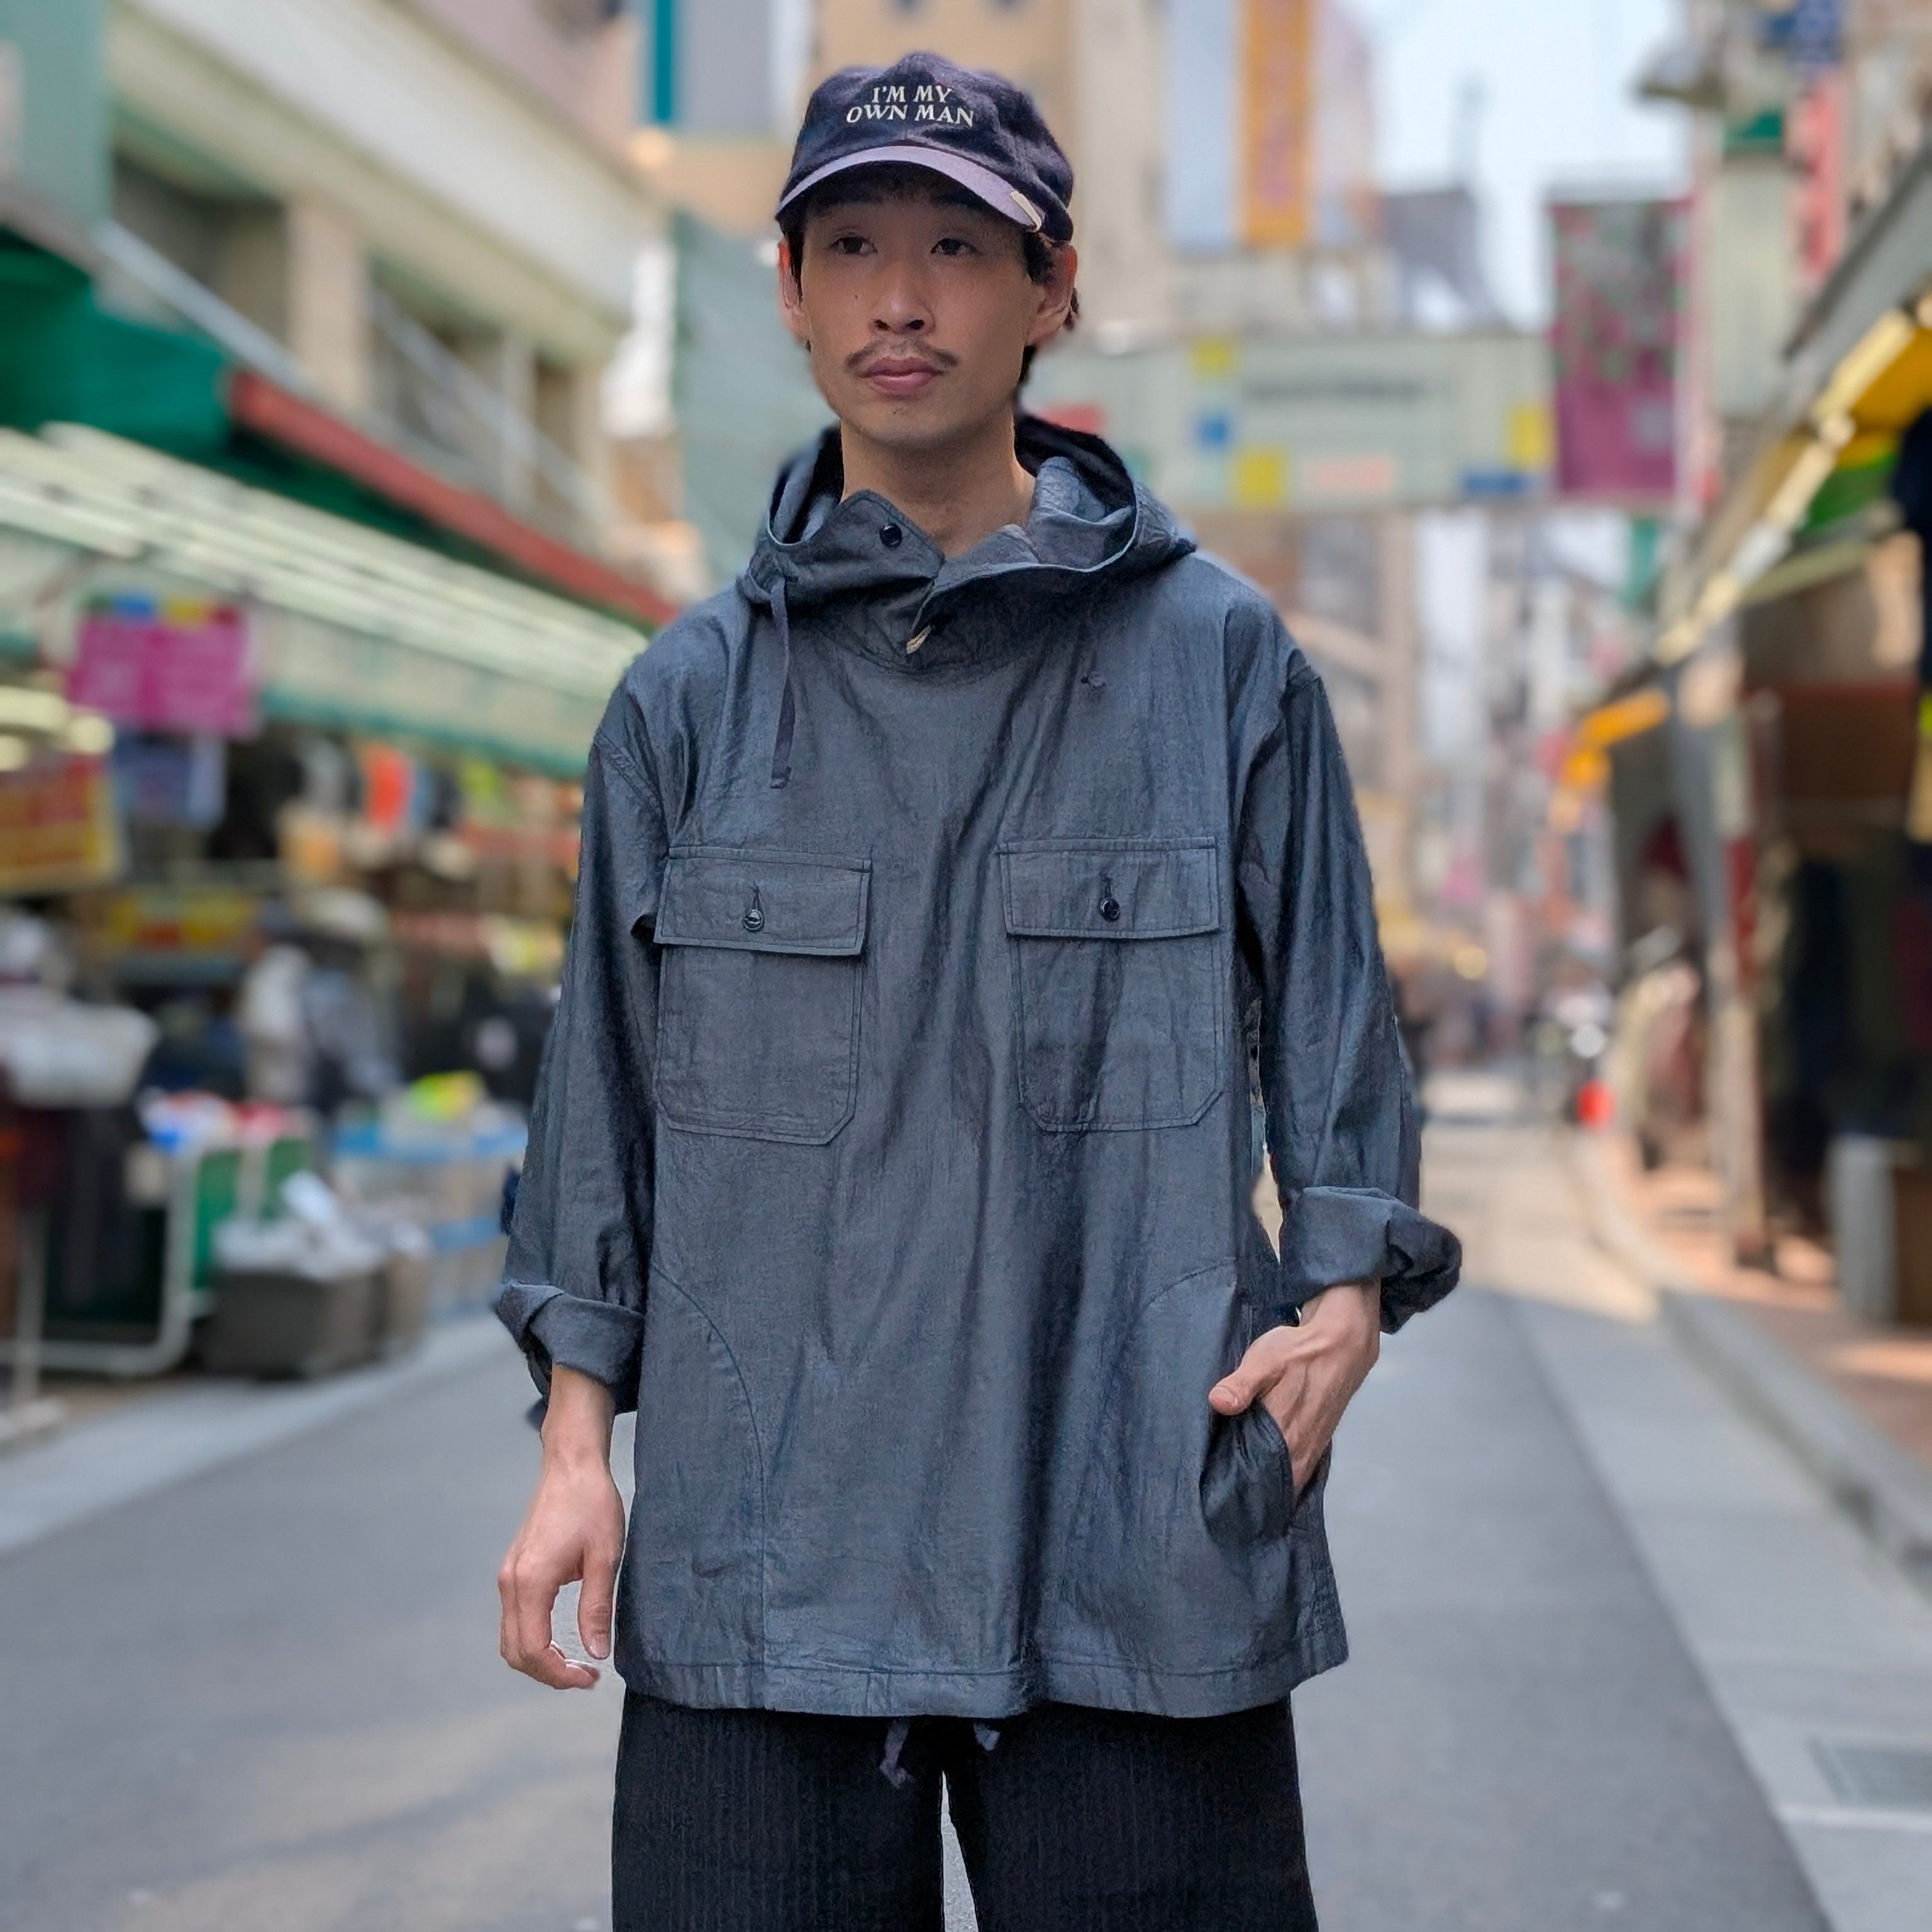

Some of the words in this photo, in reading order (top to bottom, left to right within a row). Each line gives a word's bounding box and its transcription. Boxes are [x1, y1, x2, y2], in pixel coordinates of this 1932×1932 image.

[872, 86, 906, 103] I'M
[913, 85, 953, 103] MY
[846, 104, 908, 123] OWN
[914, 104, 974, 128] MAN
